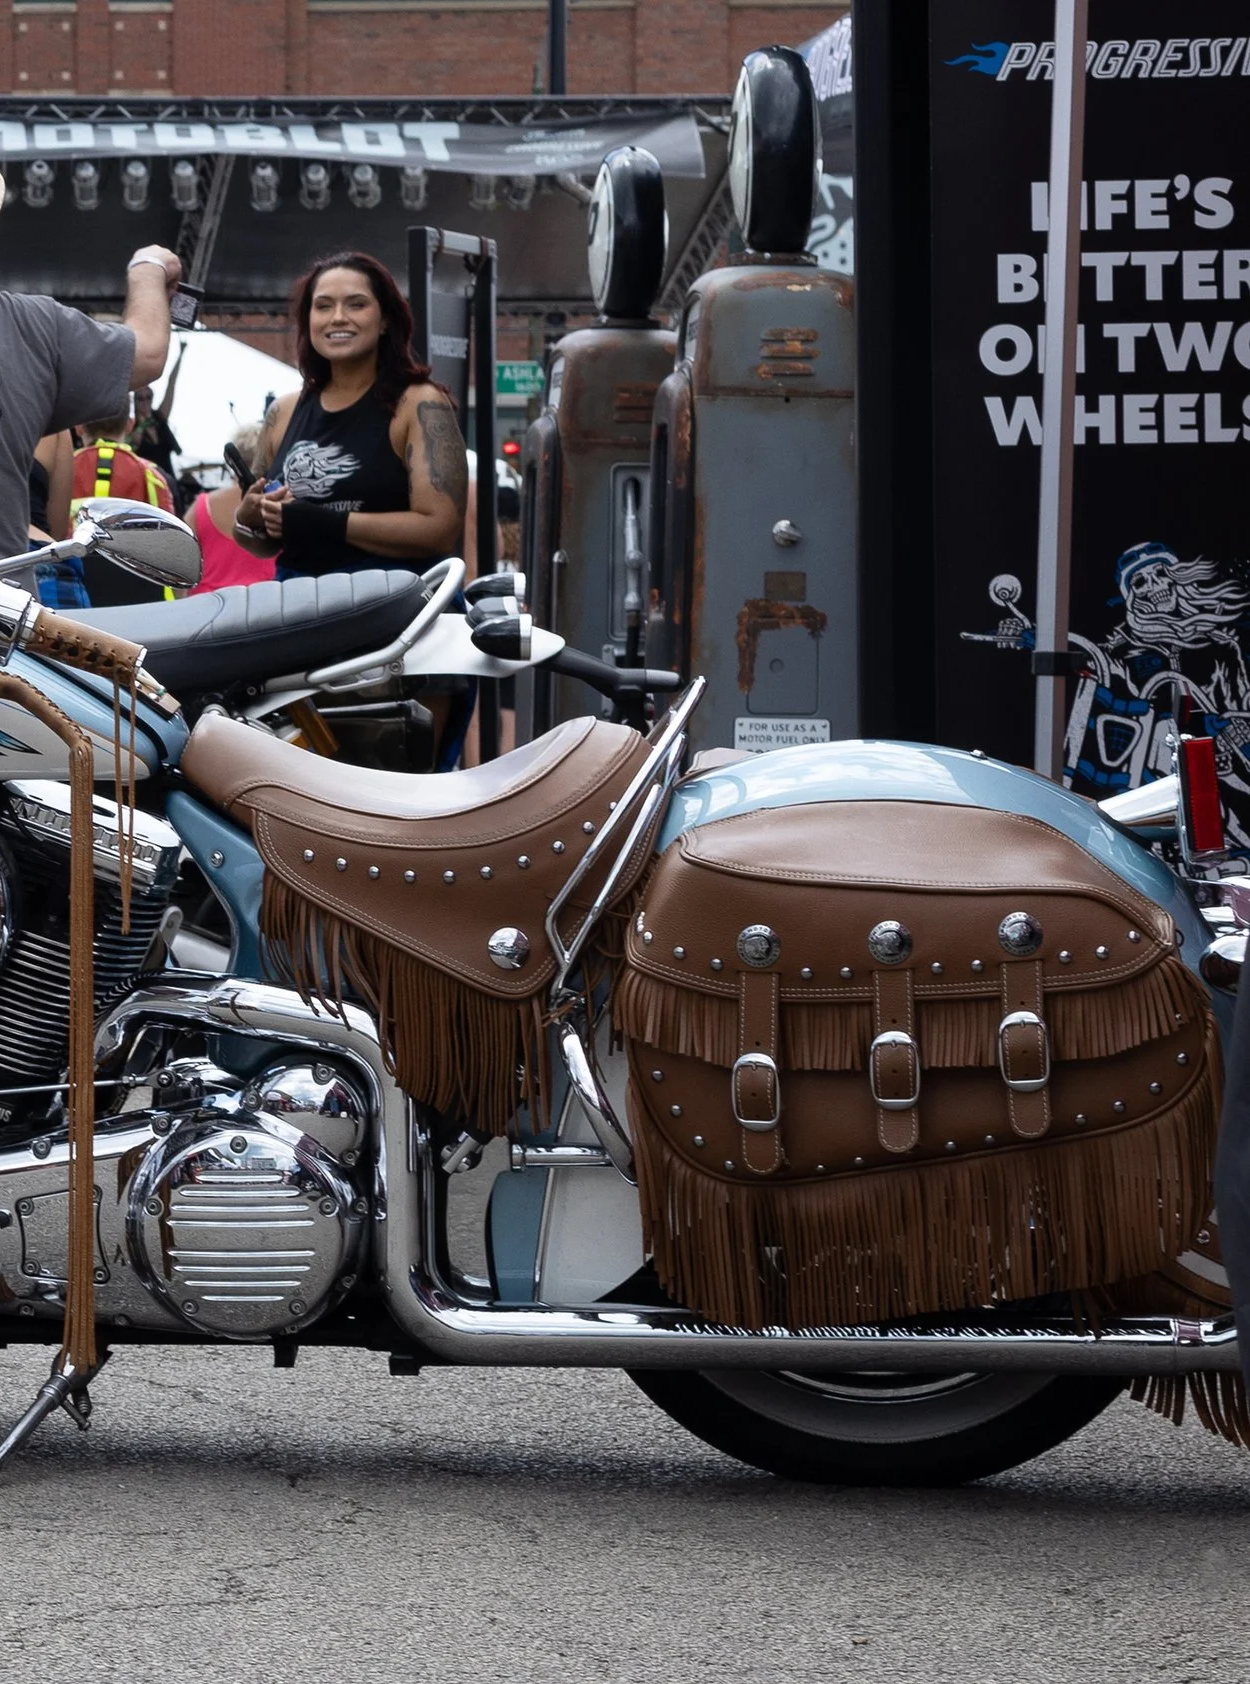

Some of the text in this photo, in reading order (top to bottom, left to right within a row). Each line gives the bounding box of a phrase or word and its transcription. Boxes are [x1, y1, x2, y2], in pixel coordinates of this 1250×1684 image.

[996, 37, 1250, 81] PRGRESSI
[997, 250, 1250, 303] BTTER
[984, 393, 1250, 446] WHEEL
[738, 734, 827, 744] MOTOR FUEL ONLY
[749, 722, 817, 733] FOR USE AS A
